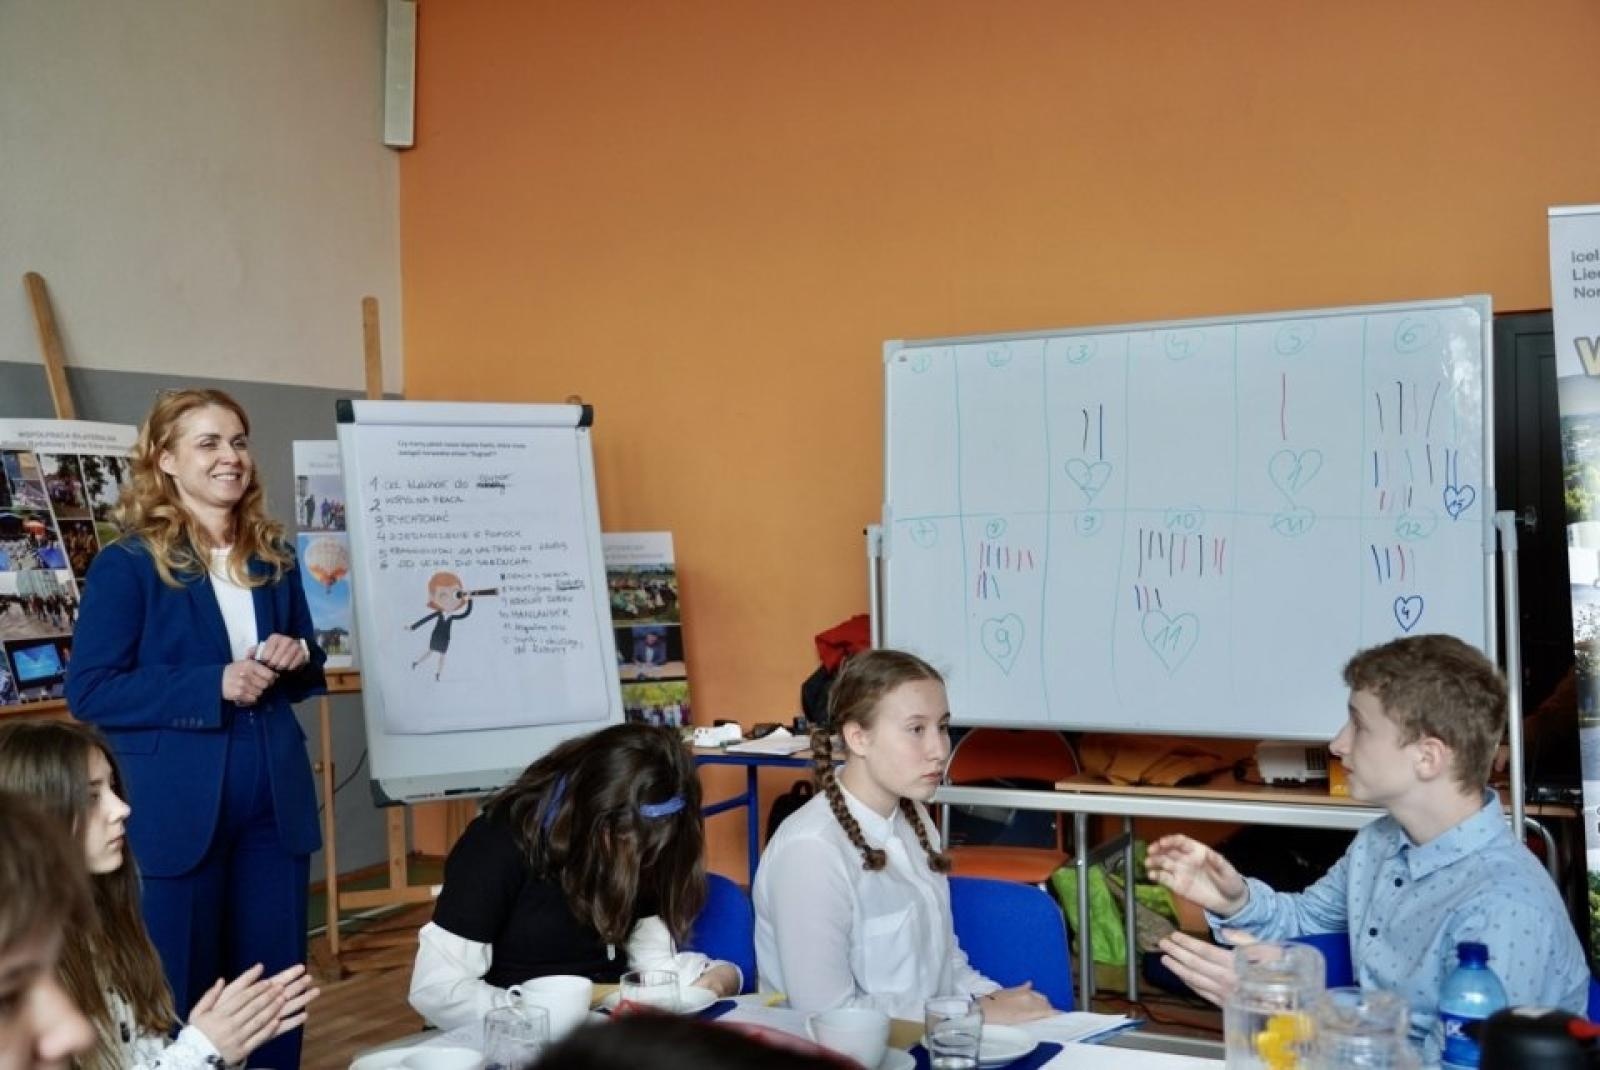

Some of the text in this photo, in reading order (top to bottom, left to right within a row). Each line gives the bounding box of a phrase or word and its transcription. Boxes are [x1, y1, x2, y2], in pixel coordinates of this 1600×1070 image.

[368, 497, 380, 512] 2
[375, 514, 385, 529] 3
[376, 530, 386, 543] 4
[1401, 605, 1409, 620] 4
[994, 627, 1012, 658] 9
[1152, 624, 1182, 652] 11
